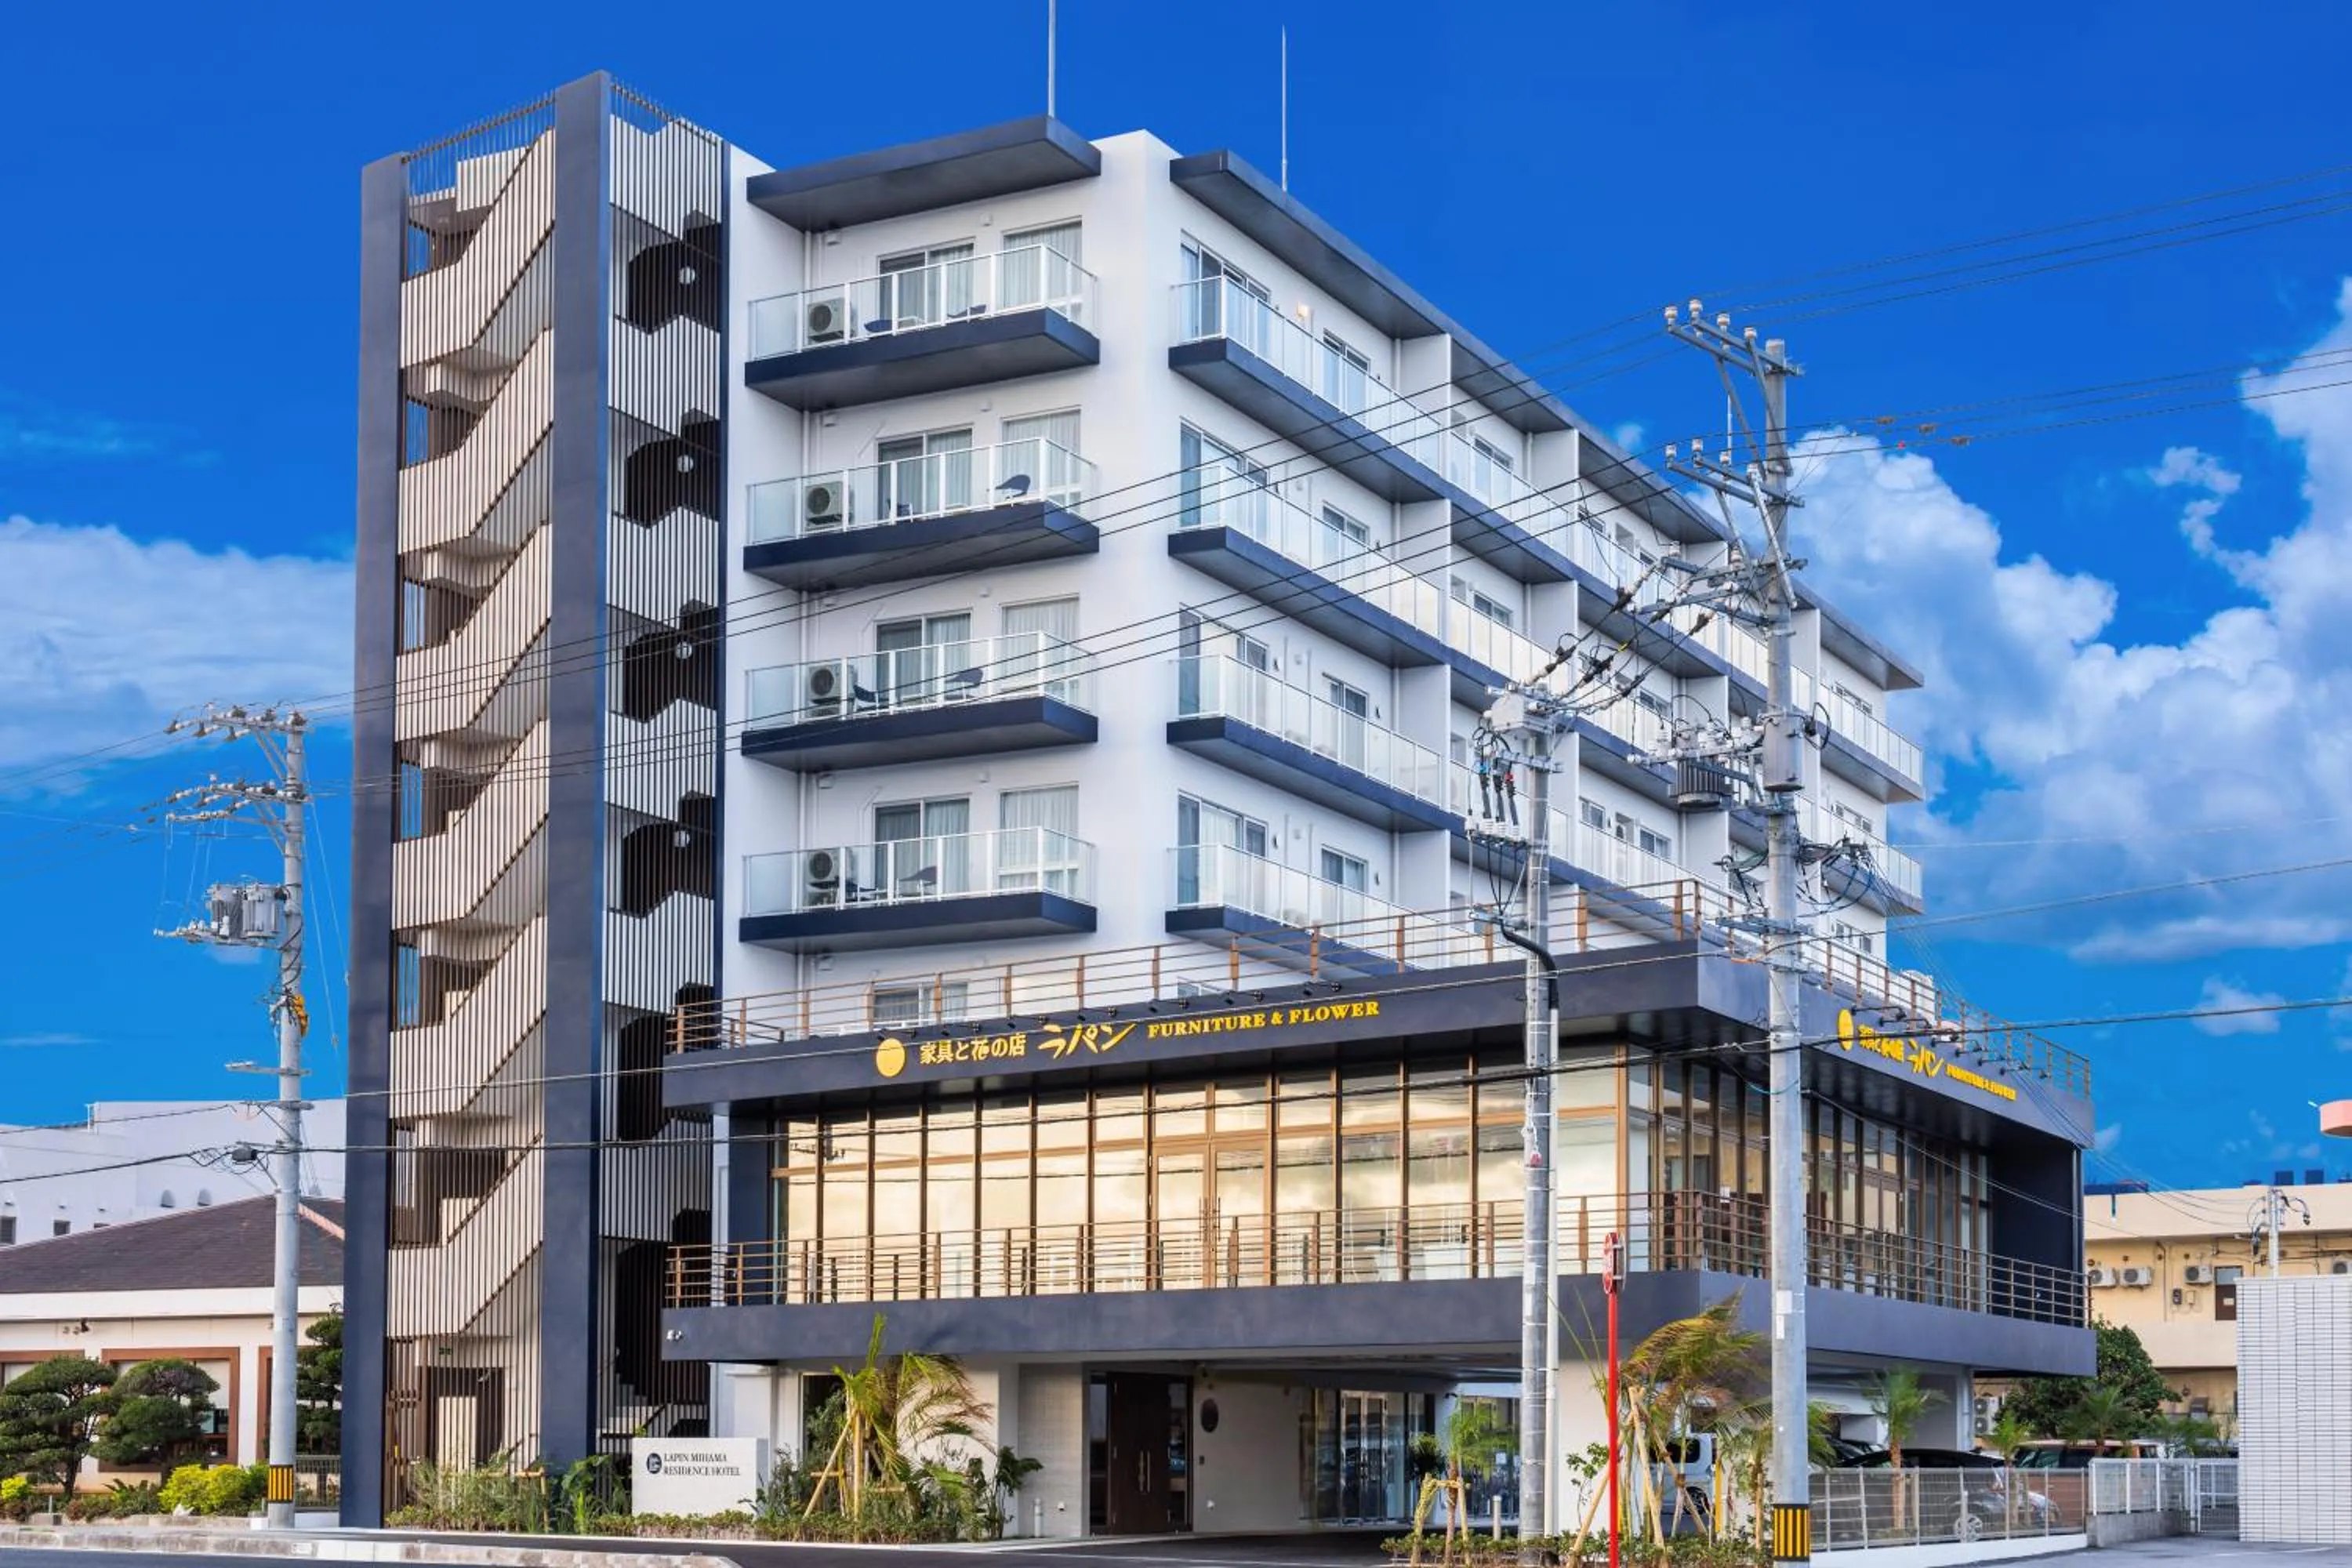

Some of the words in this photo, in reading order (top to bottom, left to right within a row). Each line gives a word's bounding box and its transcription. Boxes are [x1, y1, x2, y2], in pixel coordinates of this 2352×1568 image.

[920, 1032, 1026, 1065] 家具と花の店
[1037, 1023, 1137, 1059] ラパン
[1147, 1011, 1266, 1039] FURNITURE
[1271, 1011, 1283, 1025] &
[1289, 1000, 1380, 1024] FLOWER
